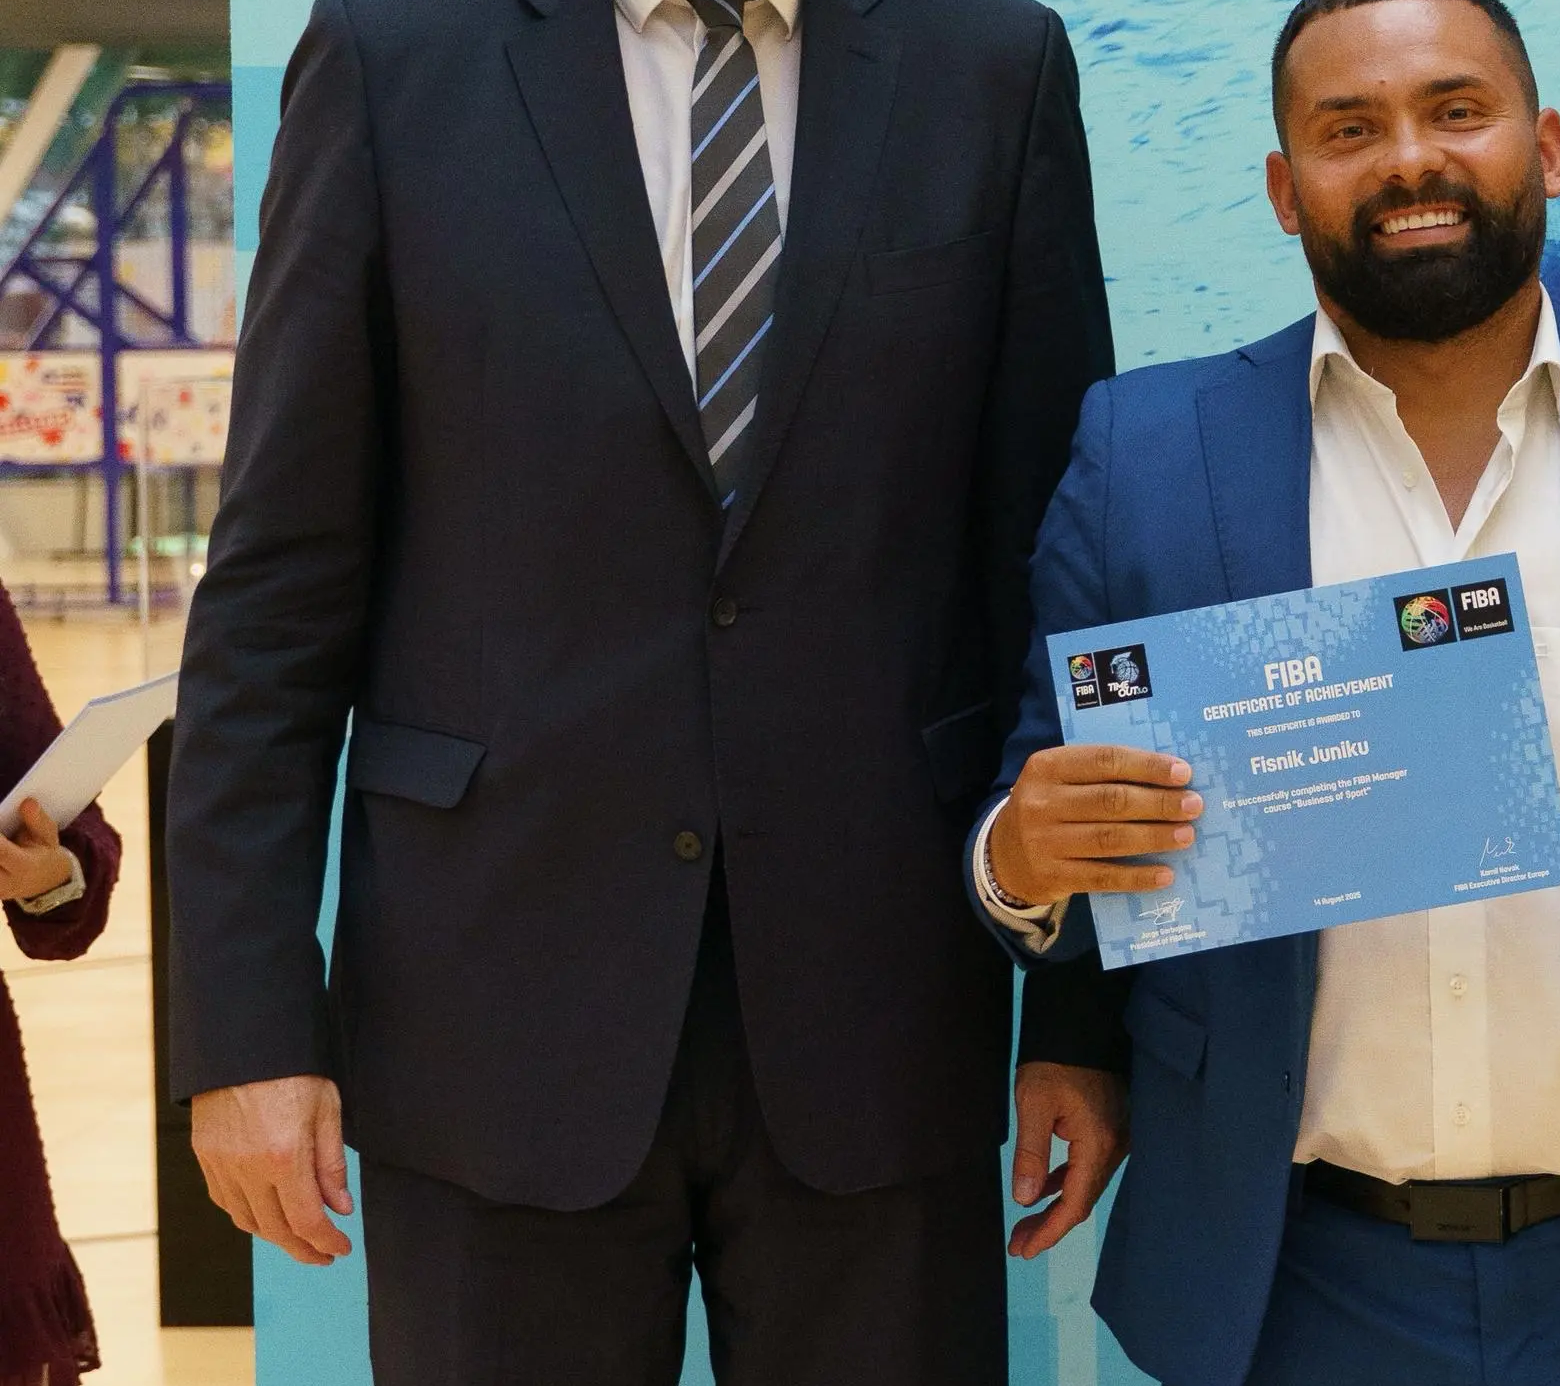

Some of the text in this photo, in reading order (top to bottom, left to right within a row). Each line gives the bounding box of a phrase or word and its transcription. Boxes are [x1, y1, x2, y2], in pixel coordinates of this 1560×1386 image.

[1460, 587, 1501, 611] FIBA
[1482, 619, 1508, 630] Basketball
[1263, 655, 1324, 691] FIBA
[1075, 684, 1095, 697] FIBA
[1107, 680, 1130, 692] TIME
[1203, 673, 1394, 722] CERTIFICATE OF ACHIEVEMENT
[1246, 710, 1361, 739] THIS CERTIFICATE IS AWARDED TO
[1250, 739, 1370, 775] Fisnik Juniku
[1222, 768, 1409, 810] For successfully completing the FIBA Manager
[1263, 803, 1293, 814] course
[1335, 791, 1345, 801] of
[1469, 877, 1501, 890] Executive
[1501, 873, 1527, 884] Director
